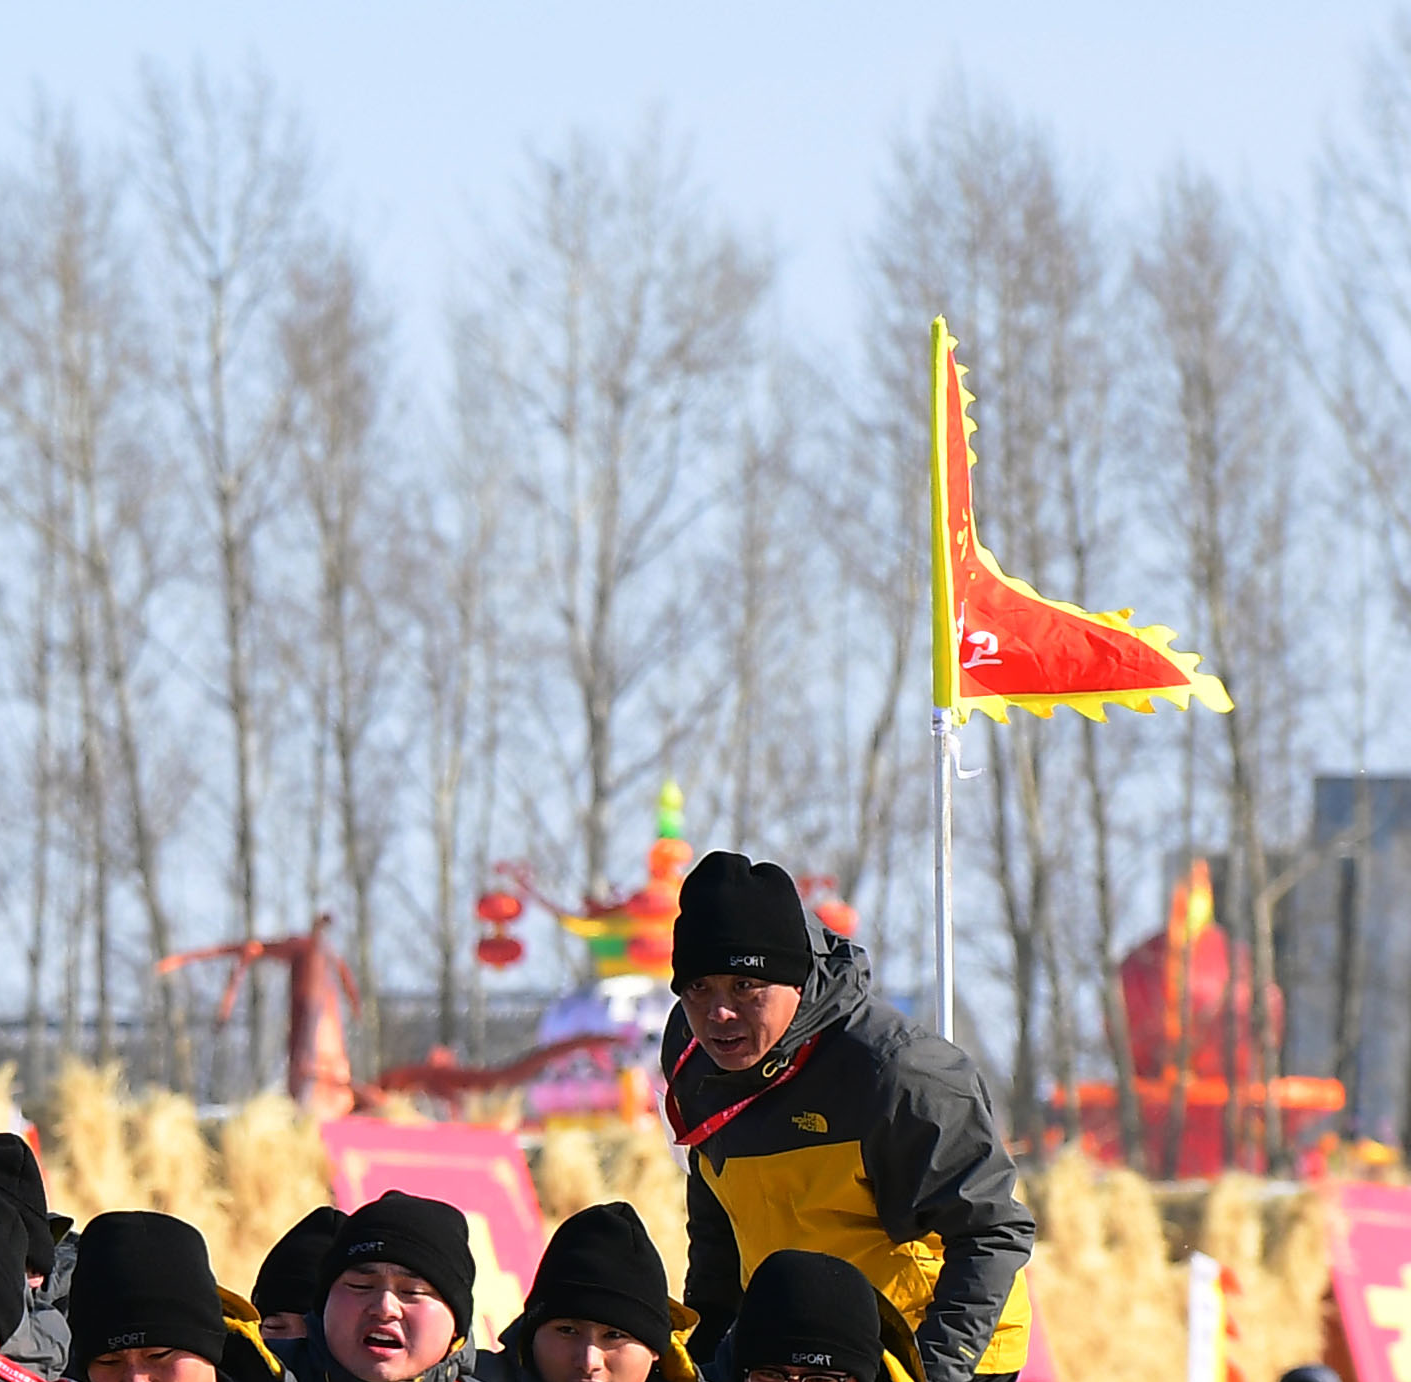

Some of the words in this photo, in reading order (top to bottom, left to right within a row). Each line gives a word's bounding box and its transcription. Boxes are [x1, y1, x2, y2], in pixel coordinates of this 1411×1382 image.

[729, 955, 767, 968] SPORT
[107, 1331, 147, 1350] SPORT
[791, 1352, 833, 1367] SPORT
